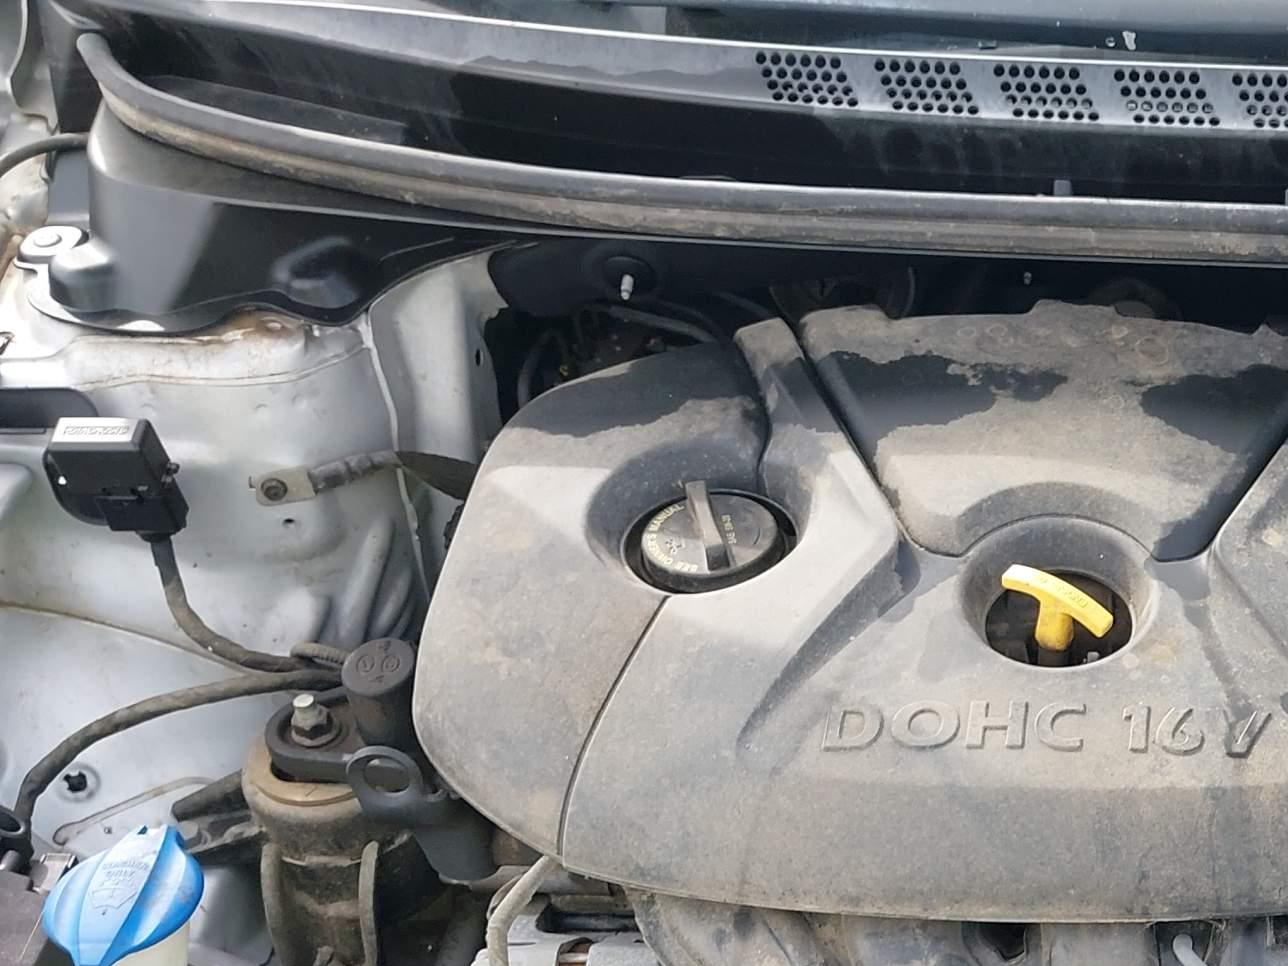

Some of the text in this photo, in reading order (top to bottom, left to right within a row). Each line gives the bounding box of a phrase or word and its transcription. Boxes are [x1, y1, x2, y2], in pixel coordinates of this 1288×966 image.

[648, 503, 685, 532] MANUAL
[820, 701, 1273, 759] DOHC 16V
